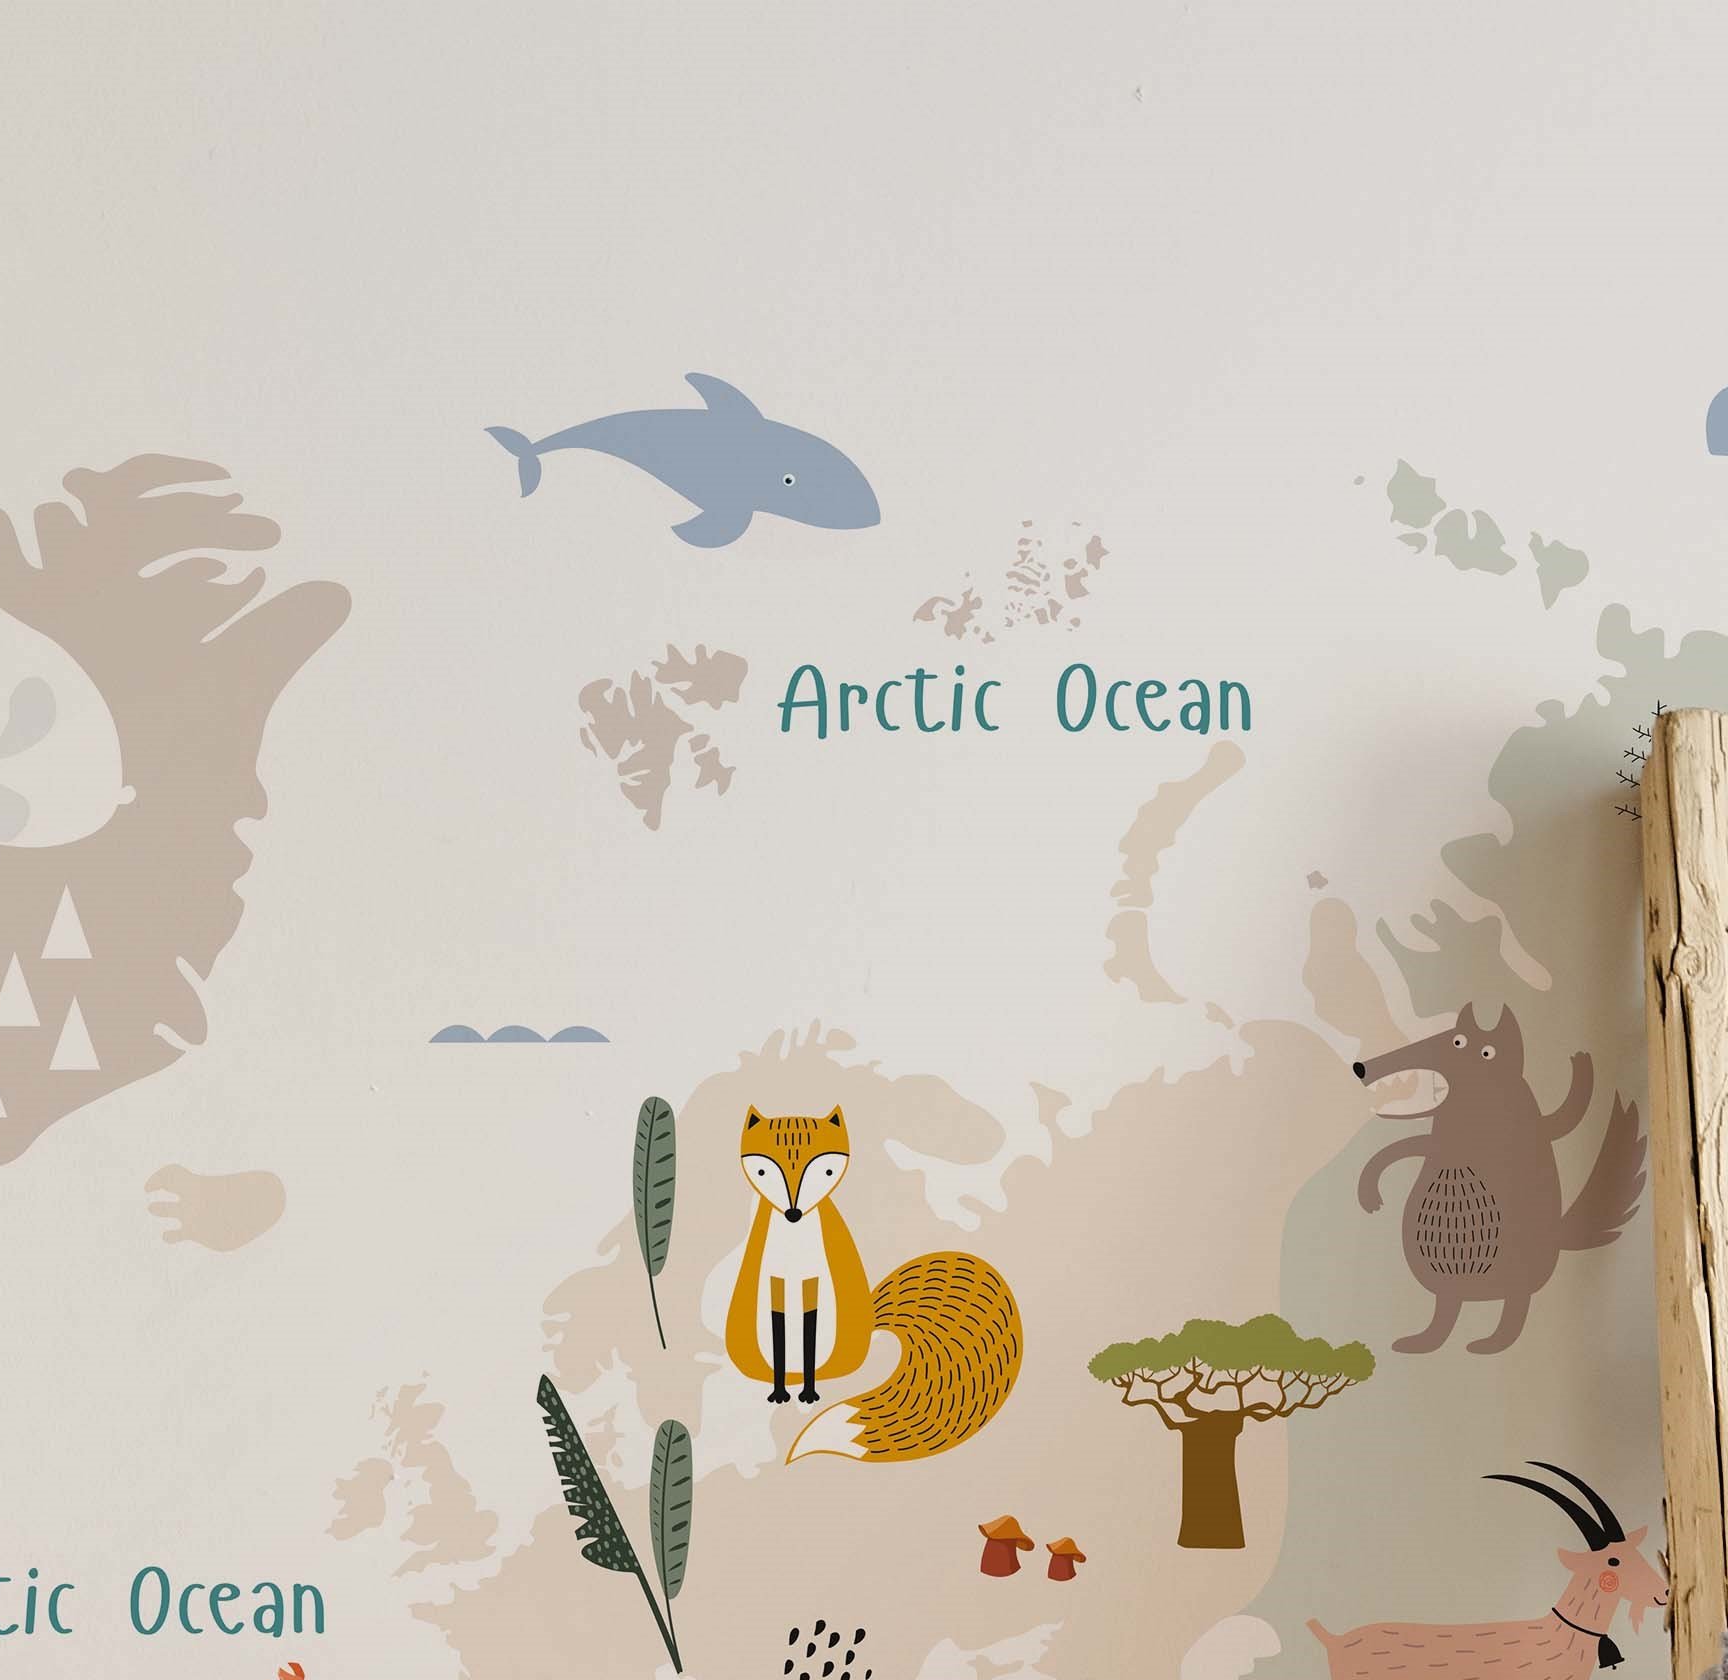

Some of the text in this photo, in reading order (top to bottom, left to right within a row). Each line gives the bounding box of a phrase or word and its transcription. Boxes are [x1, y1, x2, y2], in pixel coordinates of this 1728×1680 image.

[777, 663, 1253, 740] Arctic Ocean
[130, 1566, 326, 1639] Ocean
